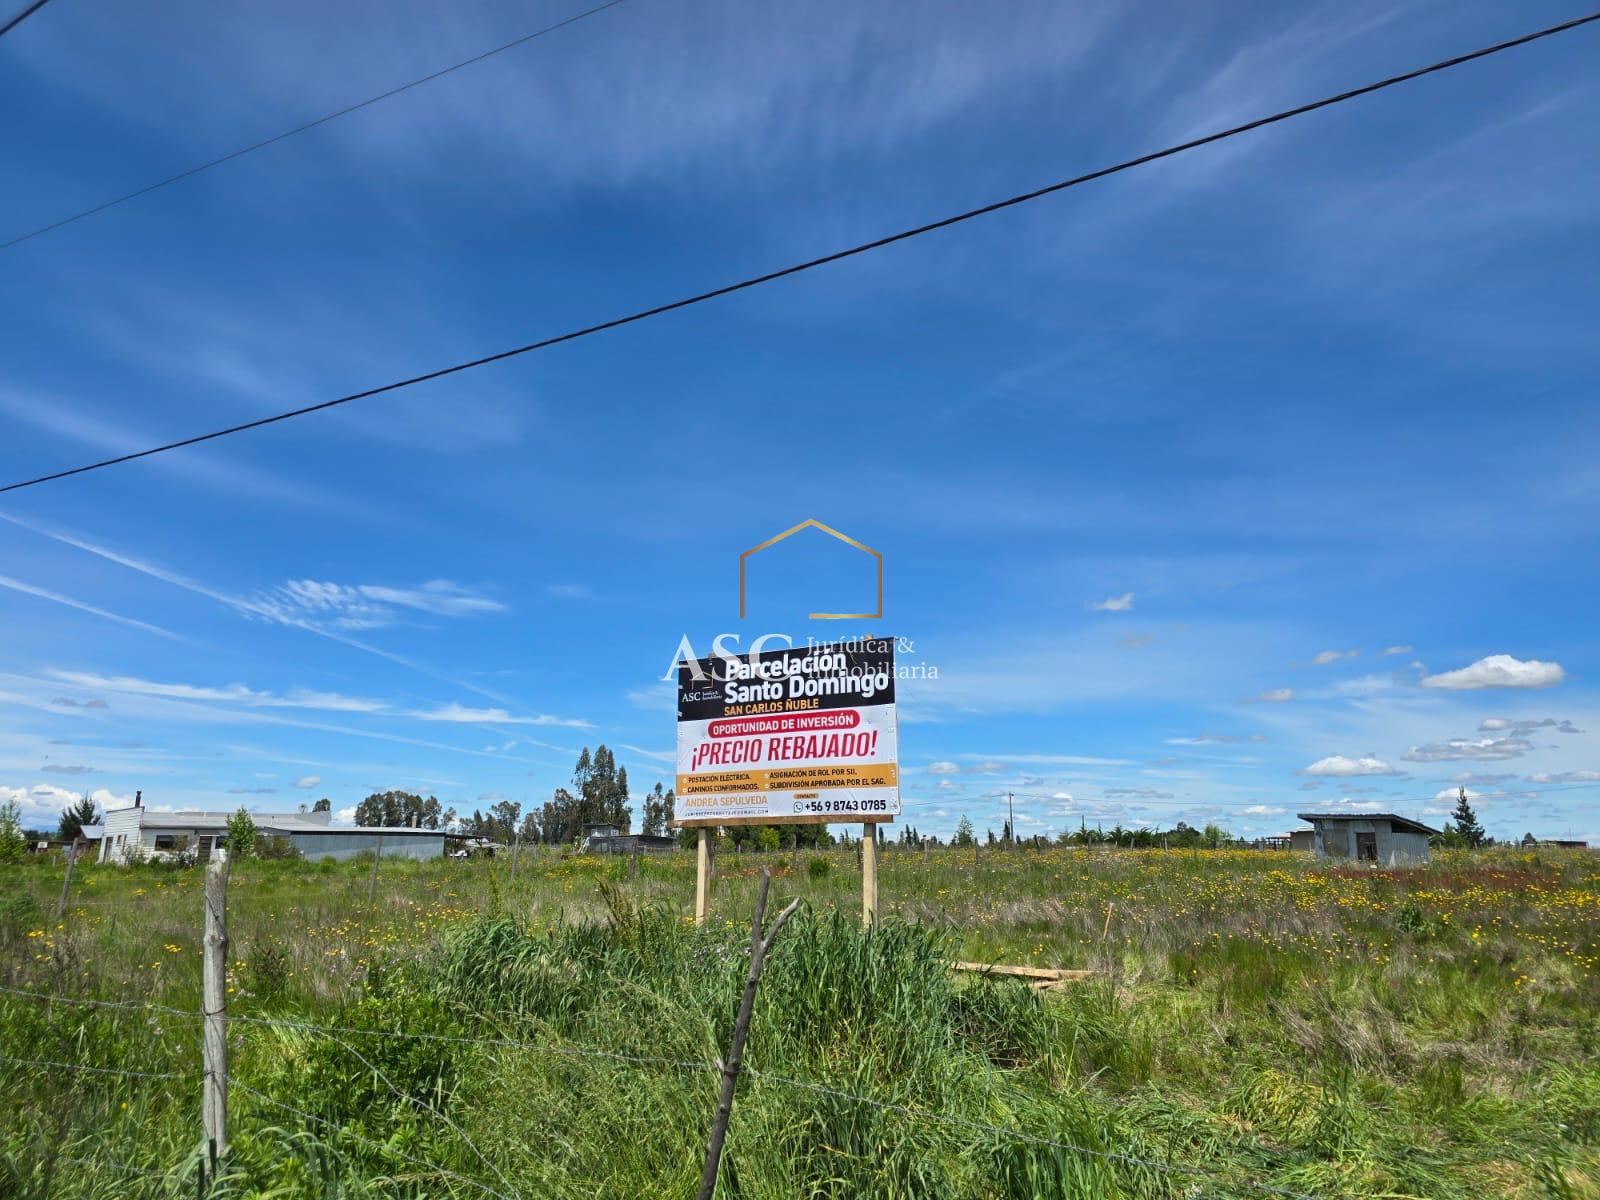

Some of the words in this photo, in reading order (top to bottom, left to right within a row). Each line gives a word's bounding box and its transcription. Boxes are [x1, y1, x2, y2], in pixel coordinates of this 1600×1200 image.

[724, 648, 846, 681] Parcelación
[682, 691, 701, 702] ASC
[724, 681, 783, 704] Santo
[789, 672, 889, 698] Domingo
[724, 706, 743, 716] SAN
[745, 702, 783, 714] CARLOS
[785, 698, 819, 711] ÑUBLE
[713, 720, 779, 735] OPORTUNIDAD
[781, 719, 795, 729] DE
[797, 713, 854, 729] INVERSIÓN
[691, 739, 763, 771] ¡PRECIO
[767, 730, 878, 761] REBAJADO!
[810, 779, 845, 787] APROBADA
[846, 778, 861, 786] POR
[862, 778, 869, 786] EL
[686, 798, 718, 807] ANDREA
[805, 802, 823, 811] +56
[824, 801, 832, 811] 9
[833, 801, 859, 811] 8743
[860, 799, 887, 810] 0785
